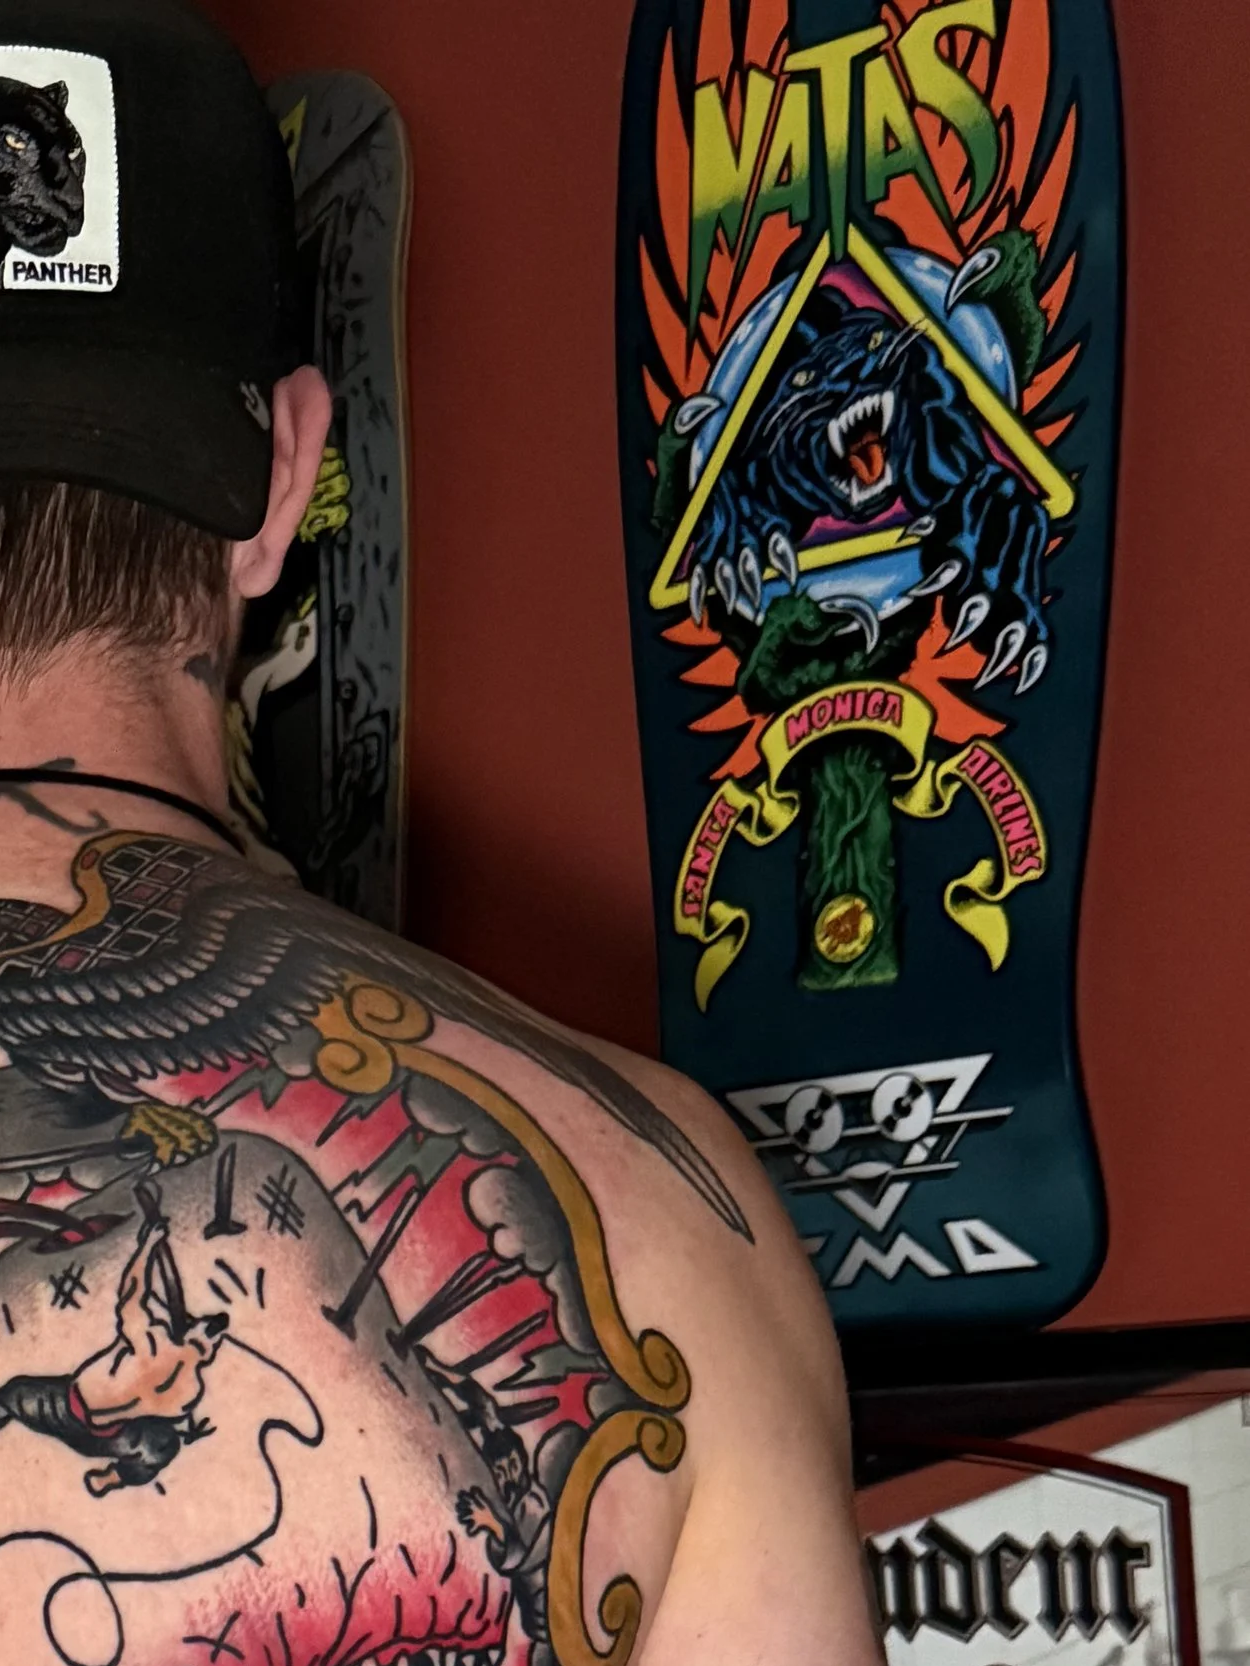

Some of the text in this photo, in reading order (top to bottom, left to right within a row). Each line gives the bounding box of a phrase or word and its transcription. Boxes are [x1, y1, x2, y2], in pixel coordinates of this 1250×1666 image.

[688, 0, 999, 328] NATAS
[13, 261, 112, 286] PANTHER
[786, 687, 904, 749] MONICA
[960, 746, 1042, 877] AIRLINES
[800, 1219, 1040, 1287] MA
